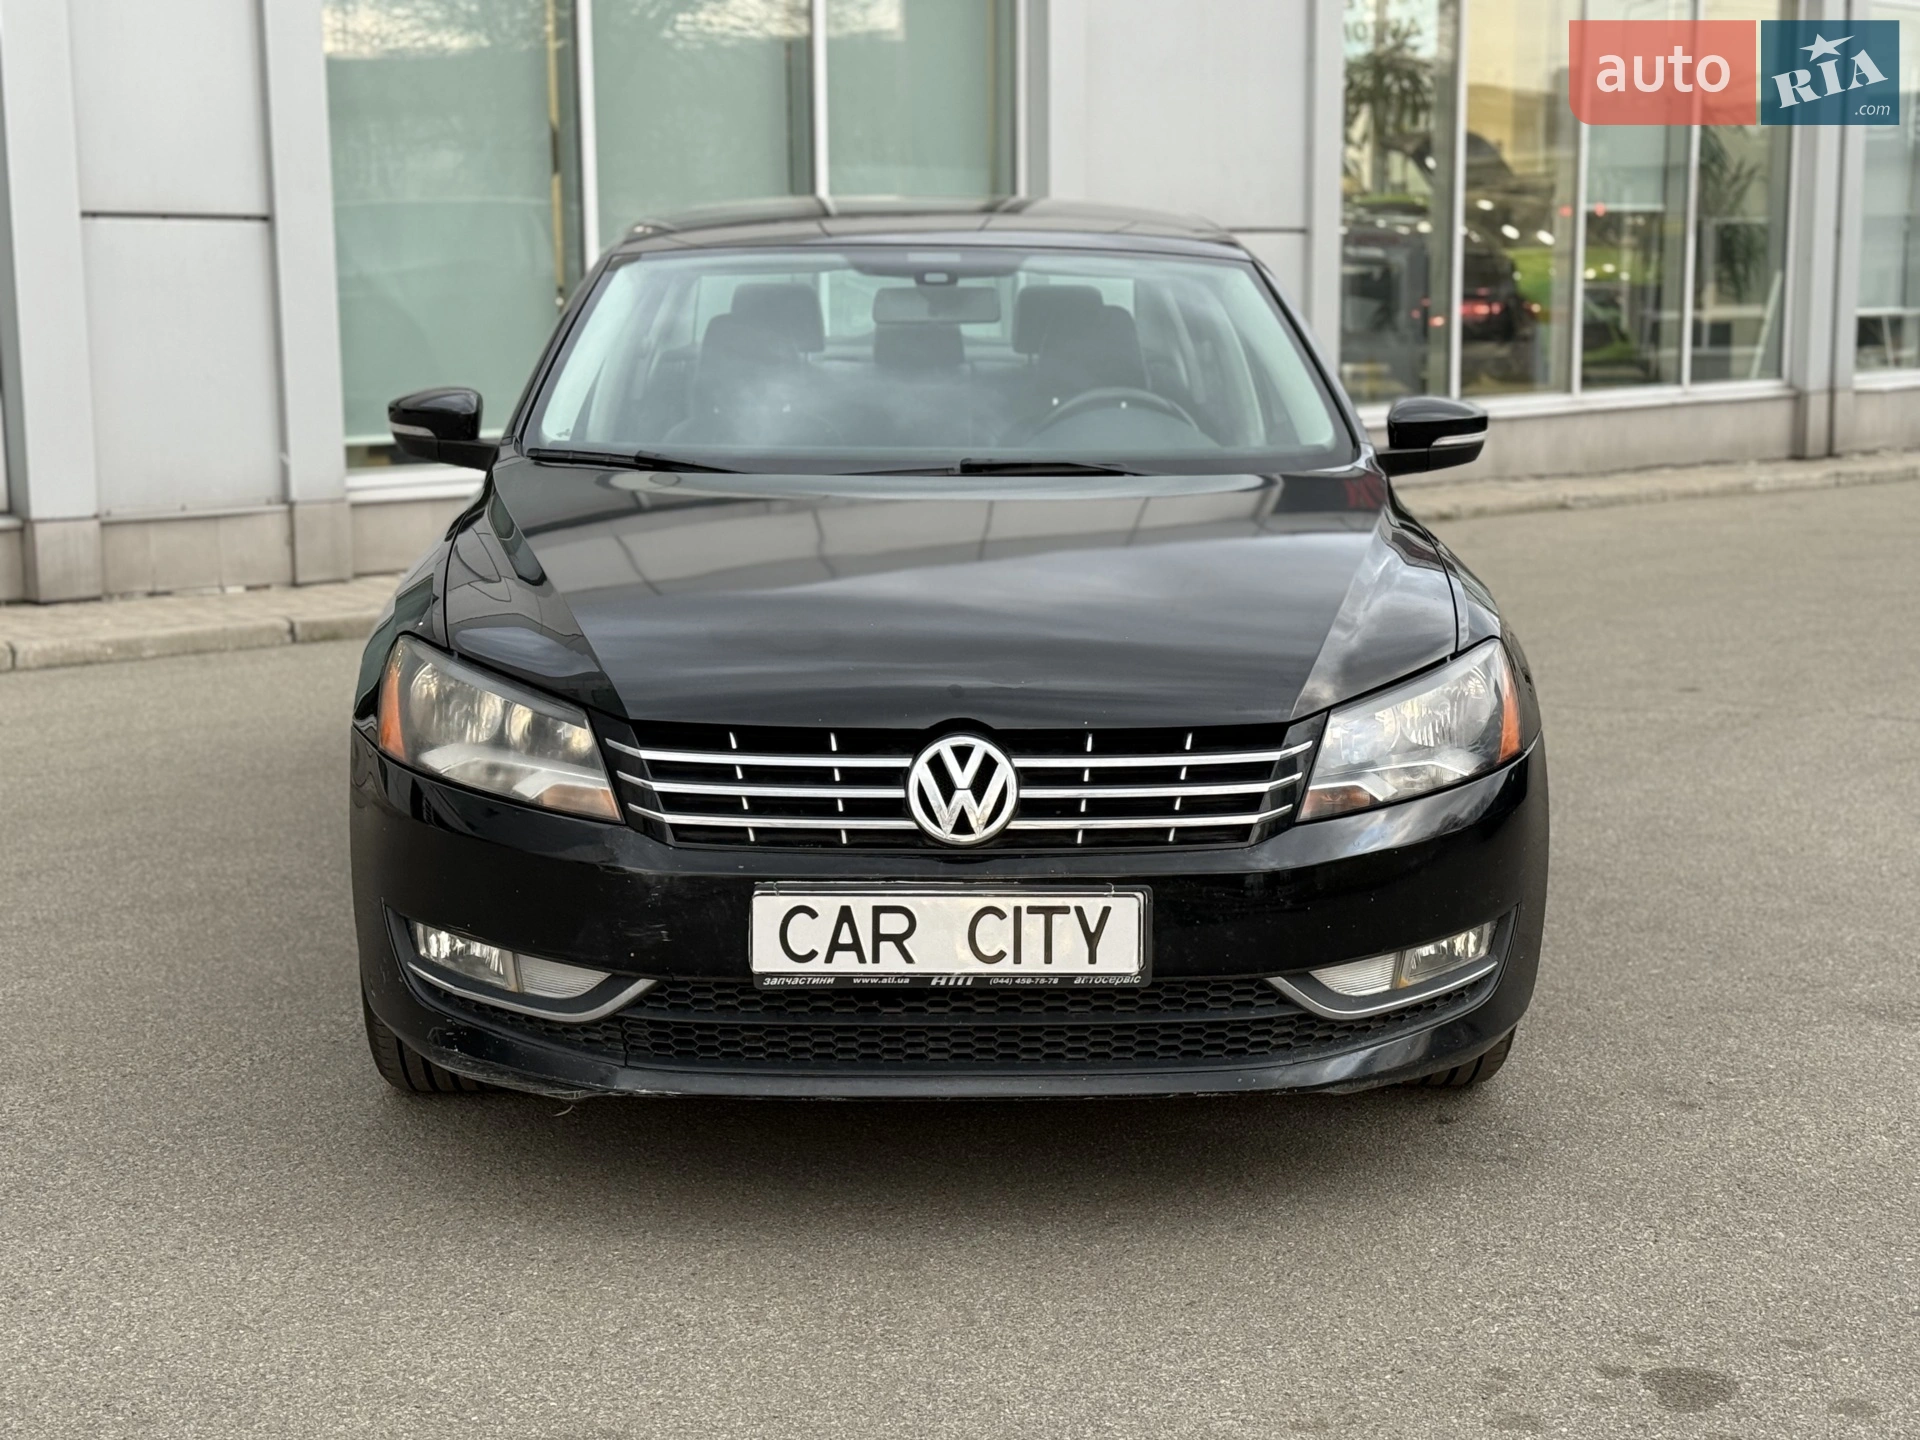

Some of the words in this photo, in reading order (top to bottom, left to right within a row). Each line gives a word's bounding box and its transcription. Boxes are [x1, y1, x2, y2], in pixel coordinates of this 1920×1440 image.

[779, 904, 917, 964] CAR
[967, 905, 1112, 965] CITY
[763, 977, 836, 986] запчастини
[989, 977, 1013, 986] (044)
